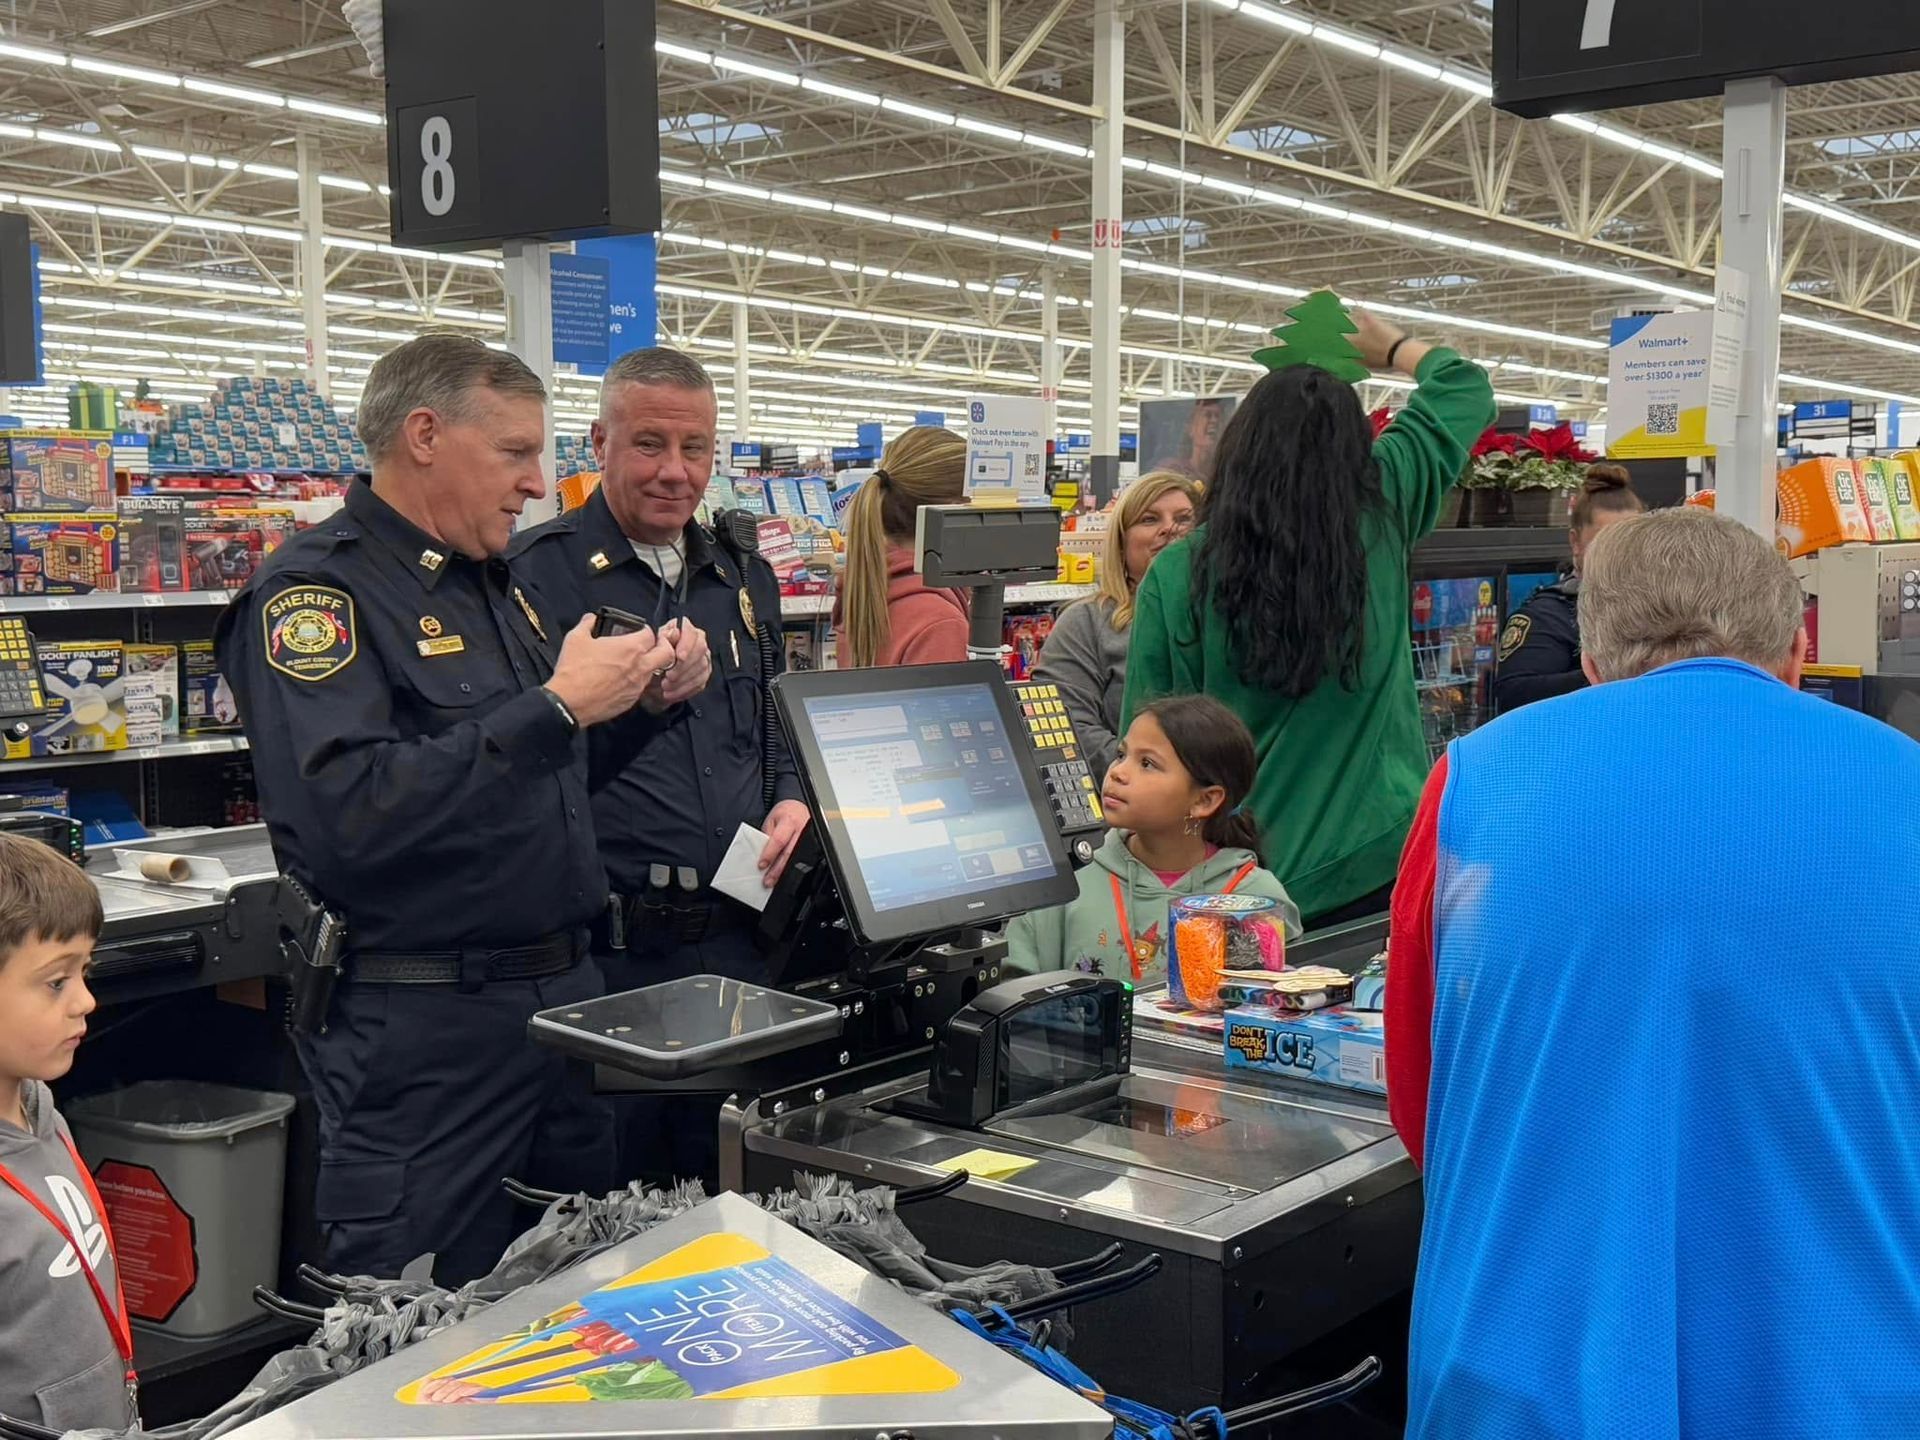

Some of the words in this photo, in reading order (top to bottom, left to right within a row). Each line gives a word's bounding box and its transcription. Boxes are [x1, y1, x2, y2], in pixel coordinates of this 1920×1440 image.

[421, 116, 455, 216] 8
[1639, 336, 1688, 348] Walmart+
[1624, 360, 1666, 369] Members
[1668, 359, 1684, 367] can
[1687, 358, 1706, 366] save
[1624, 374, 1643, 382] over
[1646, 370, 1673, 381] $1300
[1813, 404, 1826, 416] 31
[971, 427, 989, 436] Check
[122, 435, 134, 445] F1
[971, 438, 993, 446] Walmart
[994, 439, 1003, 448] Pay
[1838, 472, 1851, 488] tic
[1867, 475, 1879, 490] tic
[1896, 474, 1908, 489] tic
[1839, 488, 1854, 501] tac
[1869, 491, 1882, 504] tac
[1896, 489, 1910, 502] tac
[270, 592, 343, 617] SHERIFF
[39, 652, 72, 660] OCKET
[73, 649, 120, 659] FANLIGHT
[286, 657, 312, 666] BLOUNT
[313, 656, 339, 664] COUNTY
[97, 665, 118, 673] 1000
[294, 662, 332, 671] TENNESSEE
[1232, 1024, 1263, 1038] DON'T
[1229, 1035, 1265, 1050] BREAK
[1264, 1029, 1315, 1069] ICE
[1243, 1048, 1264, 1060] THE
[113, 1182, 134, 1193] before
[134, 1187, 146, 1197] you
[754, 1280, 769, 1291] can
[765, 1287, 780, 1297] we
[771, 1278, 796, 1295] reduce
[792, 1292, 809, 1303] and
[793, 1306, 816, 1321] more
[804, 1300, 833, 1317] prices
[674, 1278, 828, 1361] MORE
[739, 1314, 768, 1334] ITEM
[810, 1317, 829, 1330] one
[826, 1315, 843, 1327] low
[624, 1299, 743, 1366] ONE
[838, 1323, 859, 1337] with
[824, 1326, 860, 1349] packing
[853, 1334, 876, 1347] you
[695, 1342, 726, 1362] PACK
[850, 1345, 868, 1357] By
